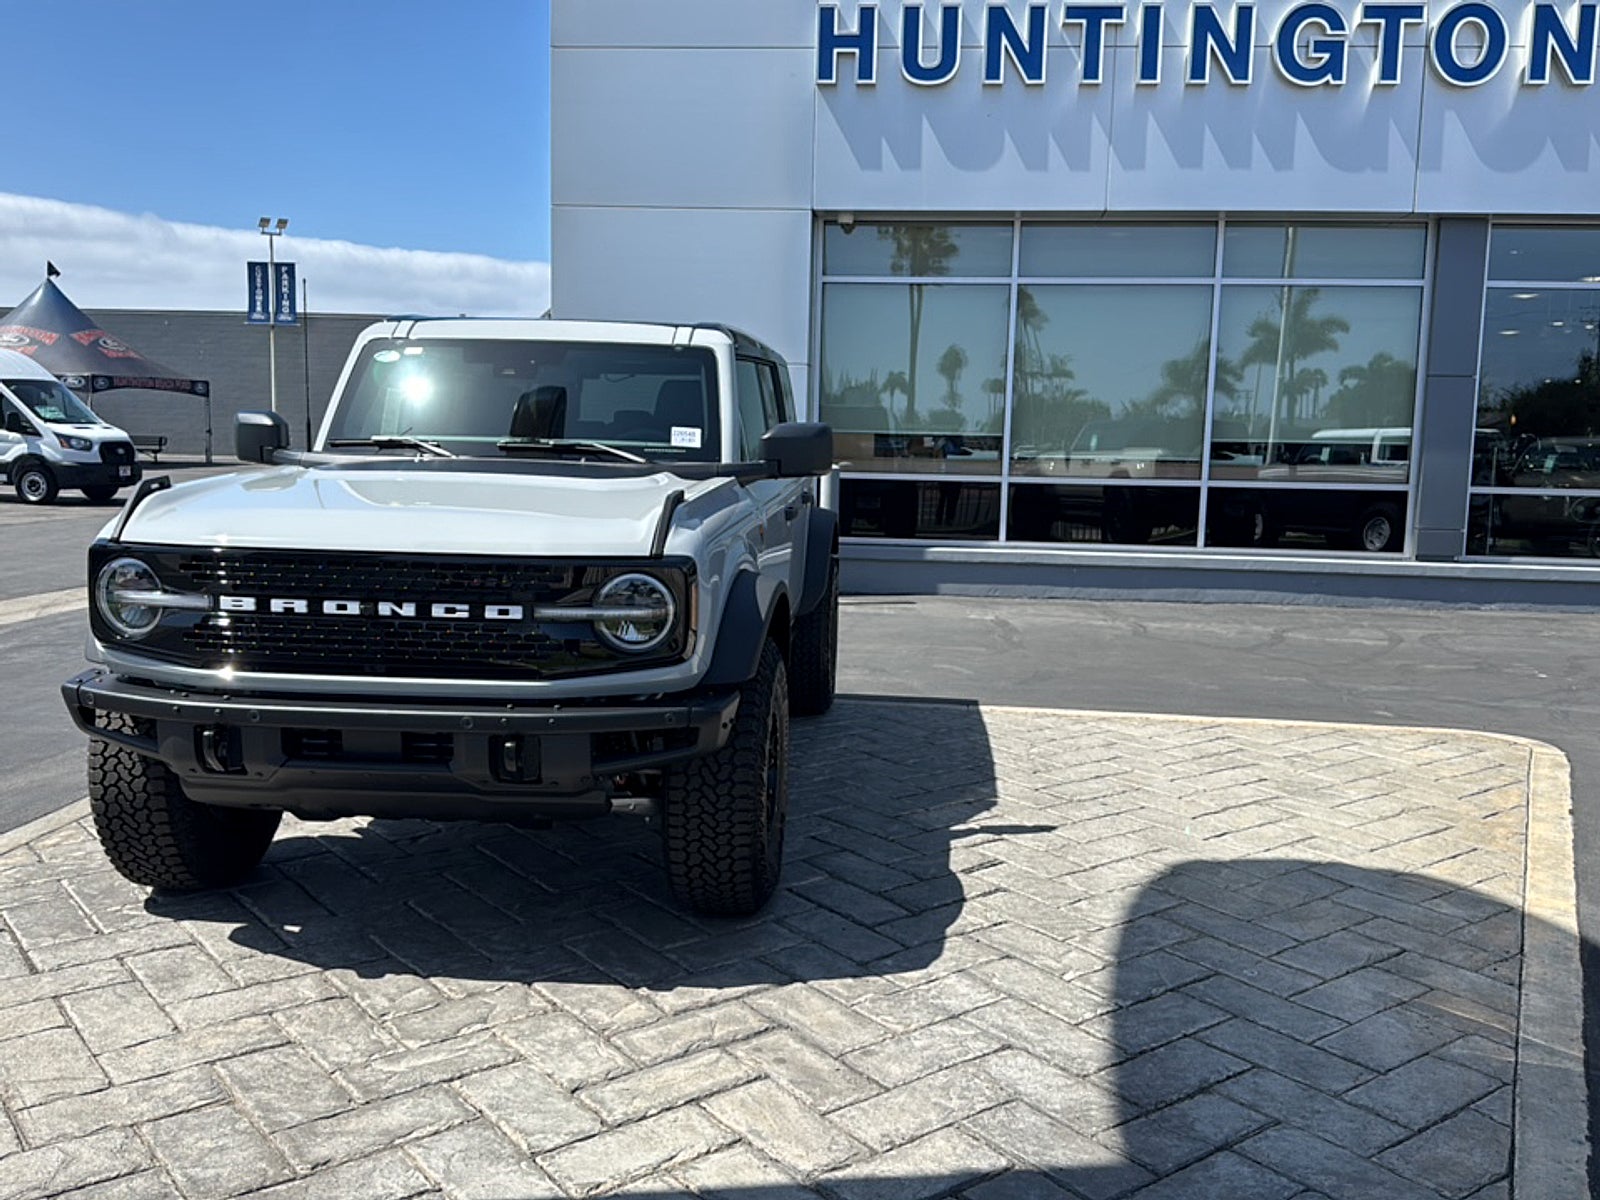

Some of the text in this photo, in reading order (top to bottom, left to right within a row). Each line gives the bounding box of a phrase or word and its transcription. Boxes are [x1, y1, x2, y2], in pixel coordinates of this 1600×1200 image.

[816, 2, 1599, 85] HUNTINGTON
[254, 265, 264, 314] CUSTOMER
[281, 266, 290, 313] PARKING
[219, 595, 523, 620] BRONCO
